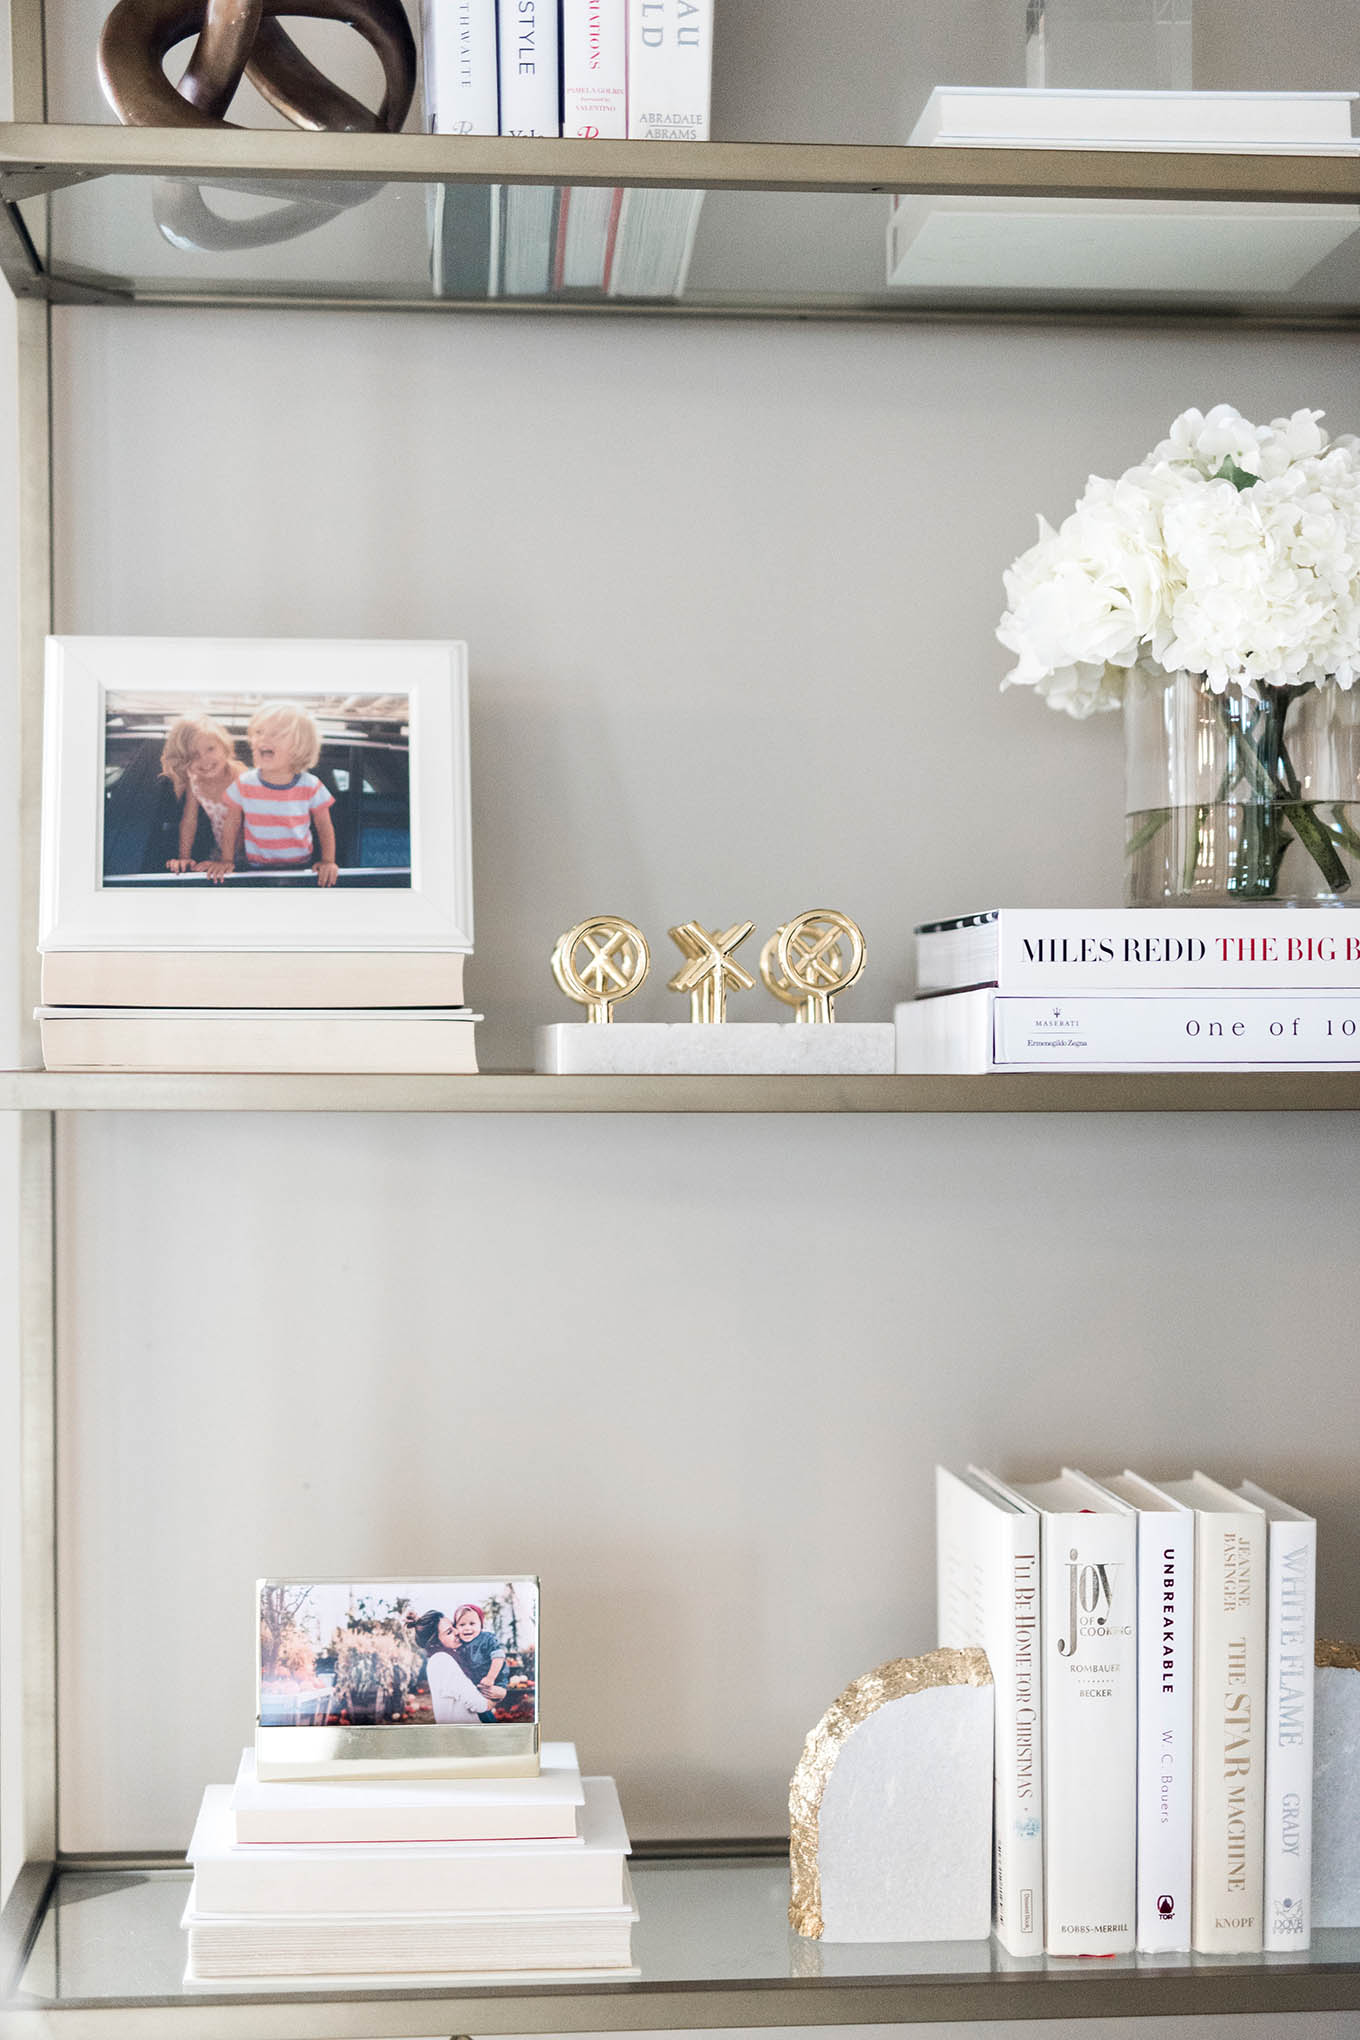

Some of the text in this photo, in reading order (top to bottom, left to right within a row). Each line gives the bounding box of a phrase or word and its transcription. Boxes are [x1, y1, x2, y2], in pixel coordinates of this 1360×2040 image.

[518, 1, 535, 75] STYLE
[641, 4, 664, 47] LD
[640, 113, 703, 124] ABRADALE
[645, 129, 697, 139] ABRAMS
[1021, 938, 1114, 962] MILES
[1123, 938, 1206, 962] REDD
[1215, 937, 1279, 961] THE
[1287, 937, 1336, 961] BIG
[1269, 1017, 1301, 1037] of
[1224, 1533, 1236, 1612] BASINGER
[1238, 1537, 1250, 1606] JEANINE
[1015, 1587, 1036, 1610] BE
[1080, 1616, 1095, 1626] OF
[1080, 1626, 1132, 1637] COOKG
[1163, 1549, 1175, 1693] UNBREAKABLE
[1016, 1616, 1036, 1668] HOME
[1279, 1545, 1308, 1747] WHITE FLAME
[1070, 1664, 1120, 1673] ROMBAUER
[1016, 1673, 1032, 1703] FOR
[1079, 1689, 1112, 1698] BECKER
[1016, 1708, 1037, 1798] CHRISTMAS
[1224, 1637, 1251, 1892] THE STAR MACHINE
[1161, 1775, 1173, 1824] Bauers
[1282, 1793, 1300, 1857] GRADY
[1061, 1923, 1128, 1934] BOBBS-MERRILL
[1215, 1917, 1255, 1928] KNOPF
